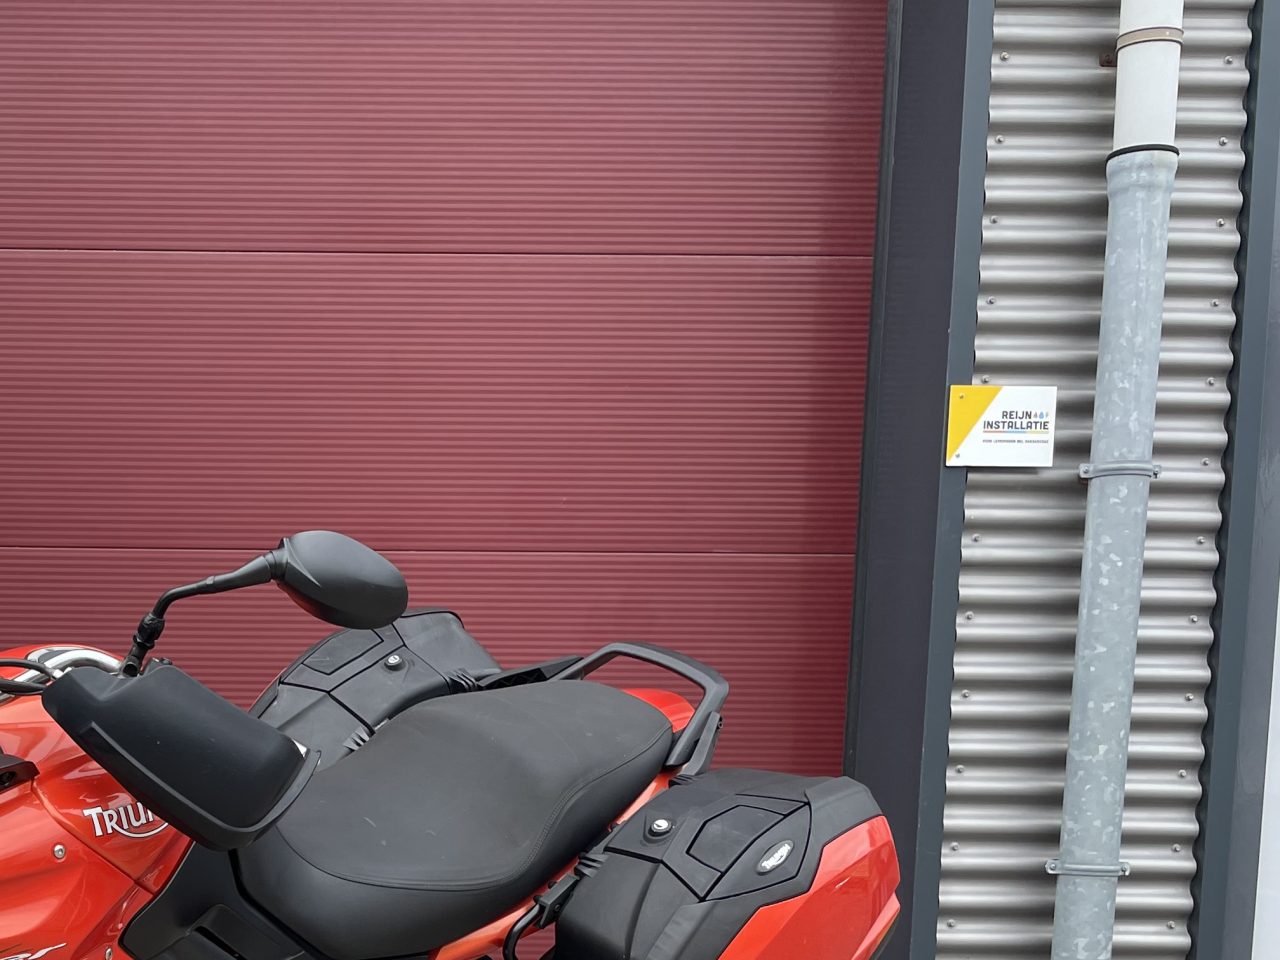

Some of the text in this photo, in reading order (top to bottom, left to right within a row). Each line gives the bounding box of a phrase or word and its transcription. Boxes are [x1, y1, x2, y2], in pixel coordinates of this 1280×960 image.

[1001, 410, 1032, 420] REIJN
[983, 420, 1050, 430] INSTALLATIE
[82, 801, 154, 837] TRIU
